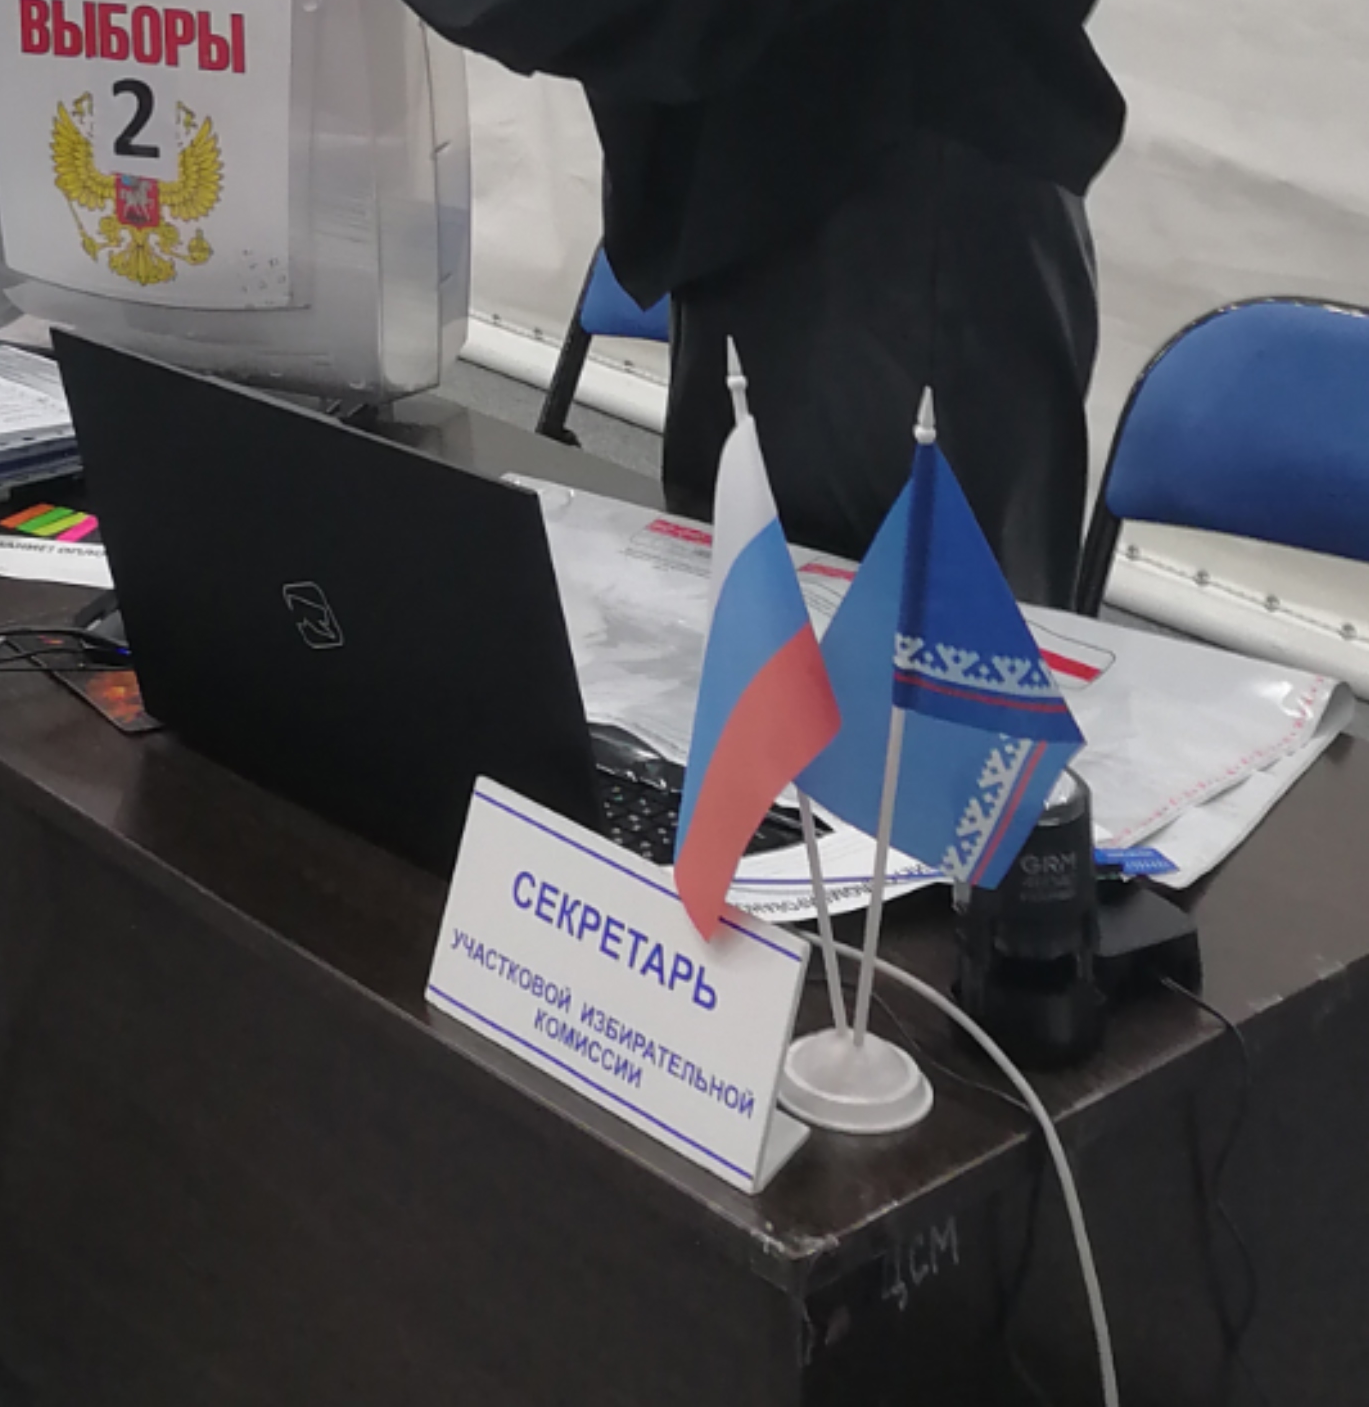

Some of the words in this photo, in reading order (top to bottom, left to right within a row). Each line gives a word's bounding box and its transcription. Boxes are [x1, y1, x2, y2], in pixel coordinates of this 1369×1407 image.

[112, 78, 161, 159] 2
[1019, 851, 1077, 875] GRM
[513, 870, 717, 1011] СЕКРЕТАРЬ
[451, 928, 572, 1013] УЧАСТКОВОЙ
[580, 1001, 756, 1120] ИЗБИРАТЕЛЬНОЙ
[534, 1007, 644, 1089] КОМИССИИ
